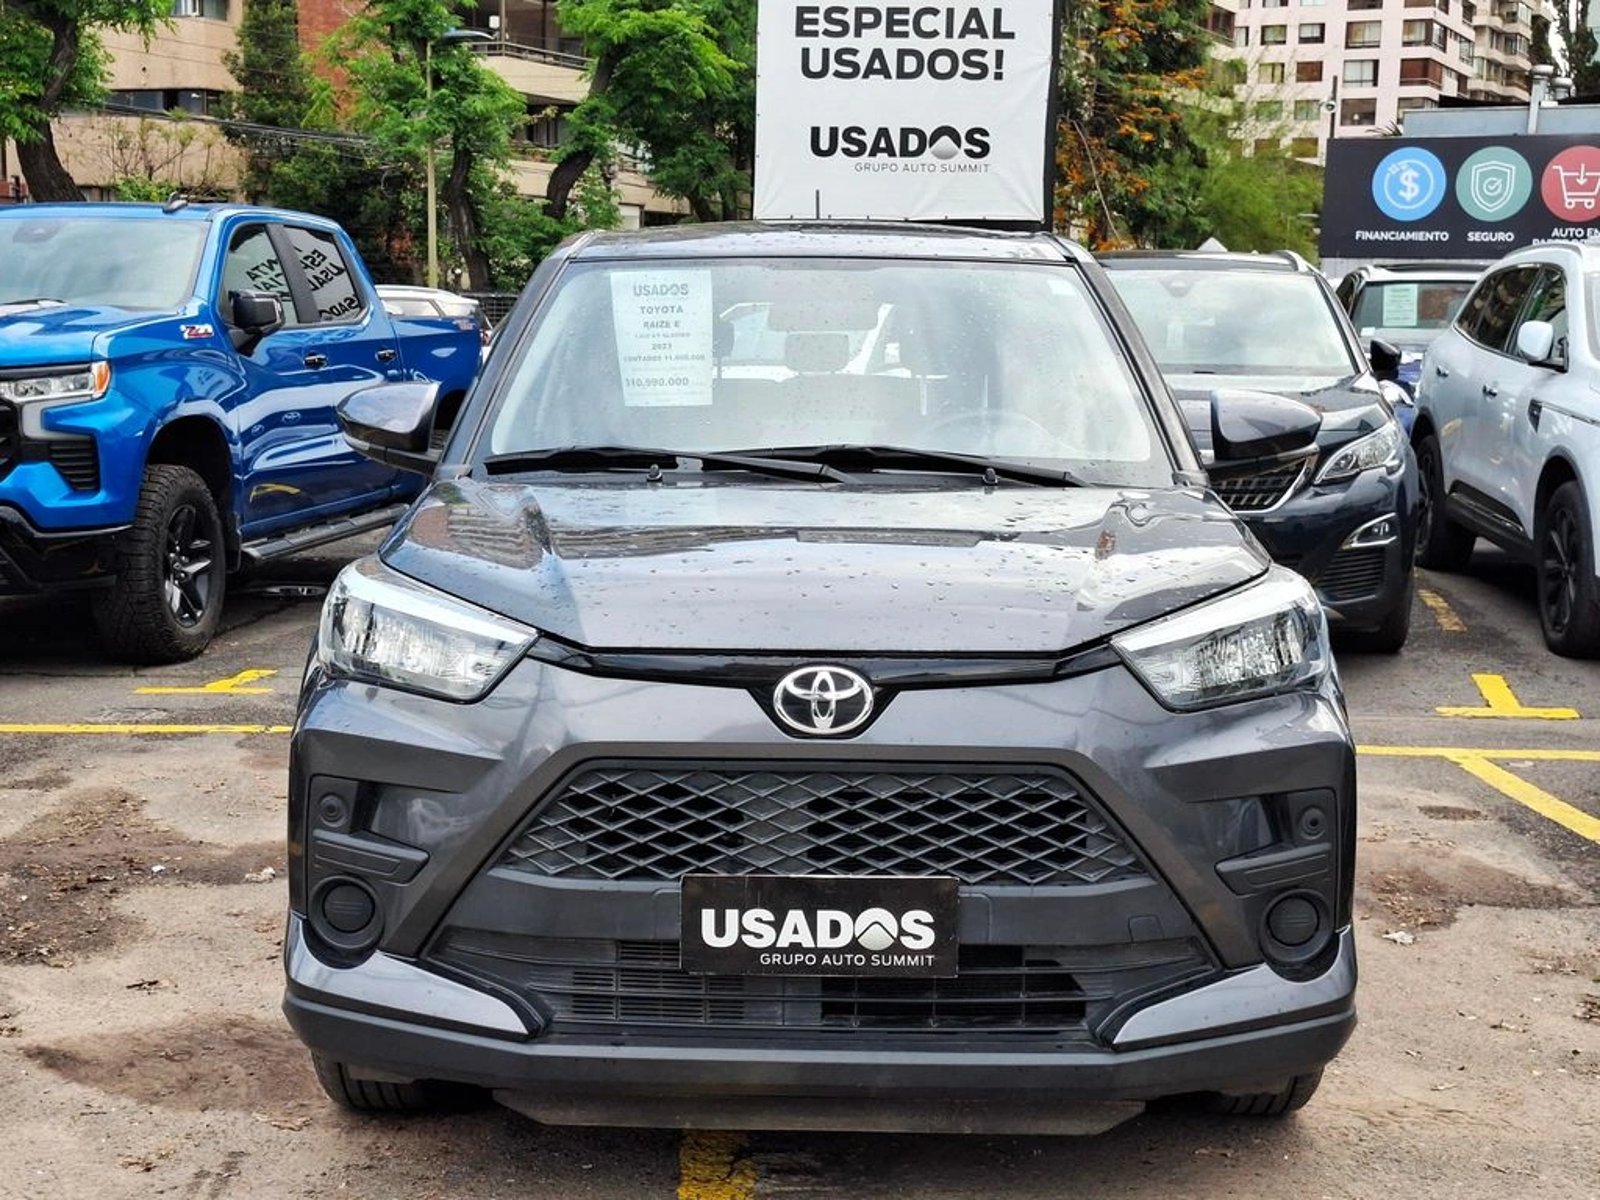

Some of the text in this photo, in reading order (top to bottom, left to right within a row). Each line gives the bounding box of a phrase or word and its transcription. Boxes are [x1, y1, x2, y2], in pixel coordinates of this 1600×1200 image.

[795, 6, 1016, 40] ESPECIAL
[801, 47, 1004, 81] USADOS!
[810, 125, 991, 160] USADOS
[854, 162, 991, 173] GRUPO AUTO SUMMIT
[1355, 230, 1450, 242] FINANCIAMIENTO
[1467, 231, 1515, 242] SEGURO
[1551, 227, 1585, 238] AUTO
[633, 283, 689, 297] USADOS
[640, 305, 684, 315] TOYOTA
[701, 907, 936, 951] USADOS
[760, 953, 935, 967] GRUPO AUTO SUMMIT
